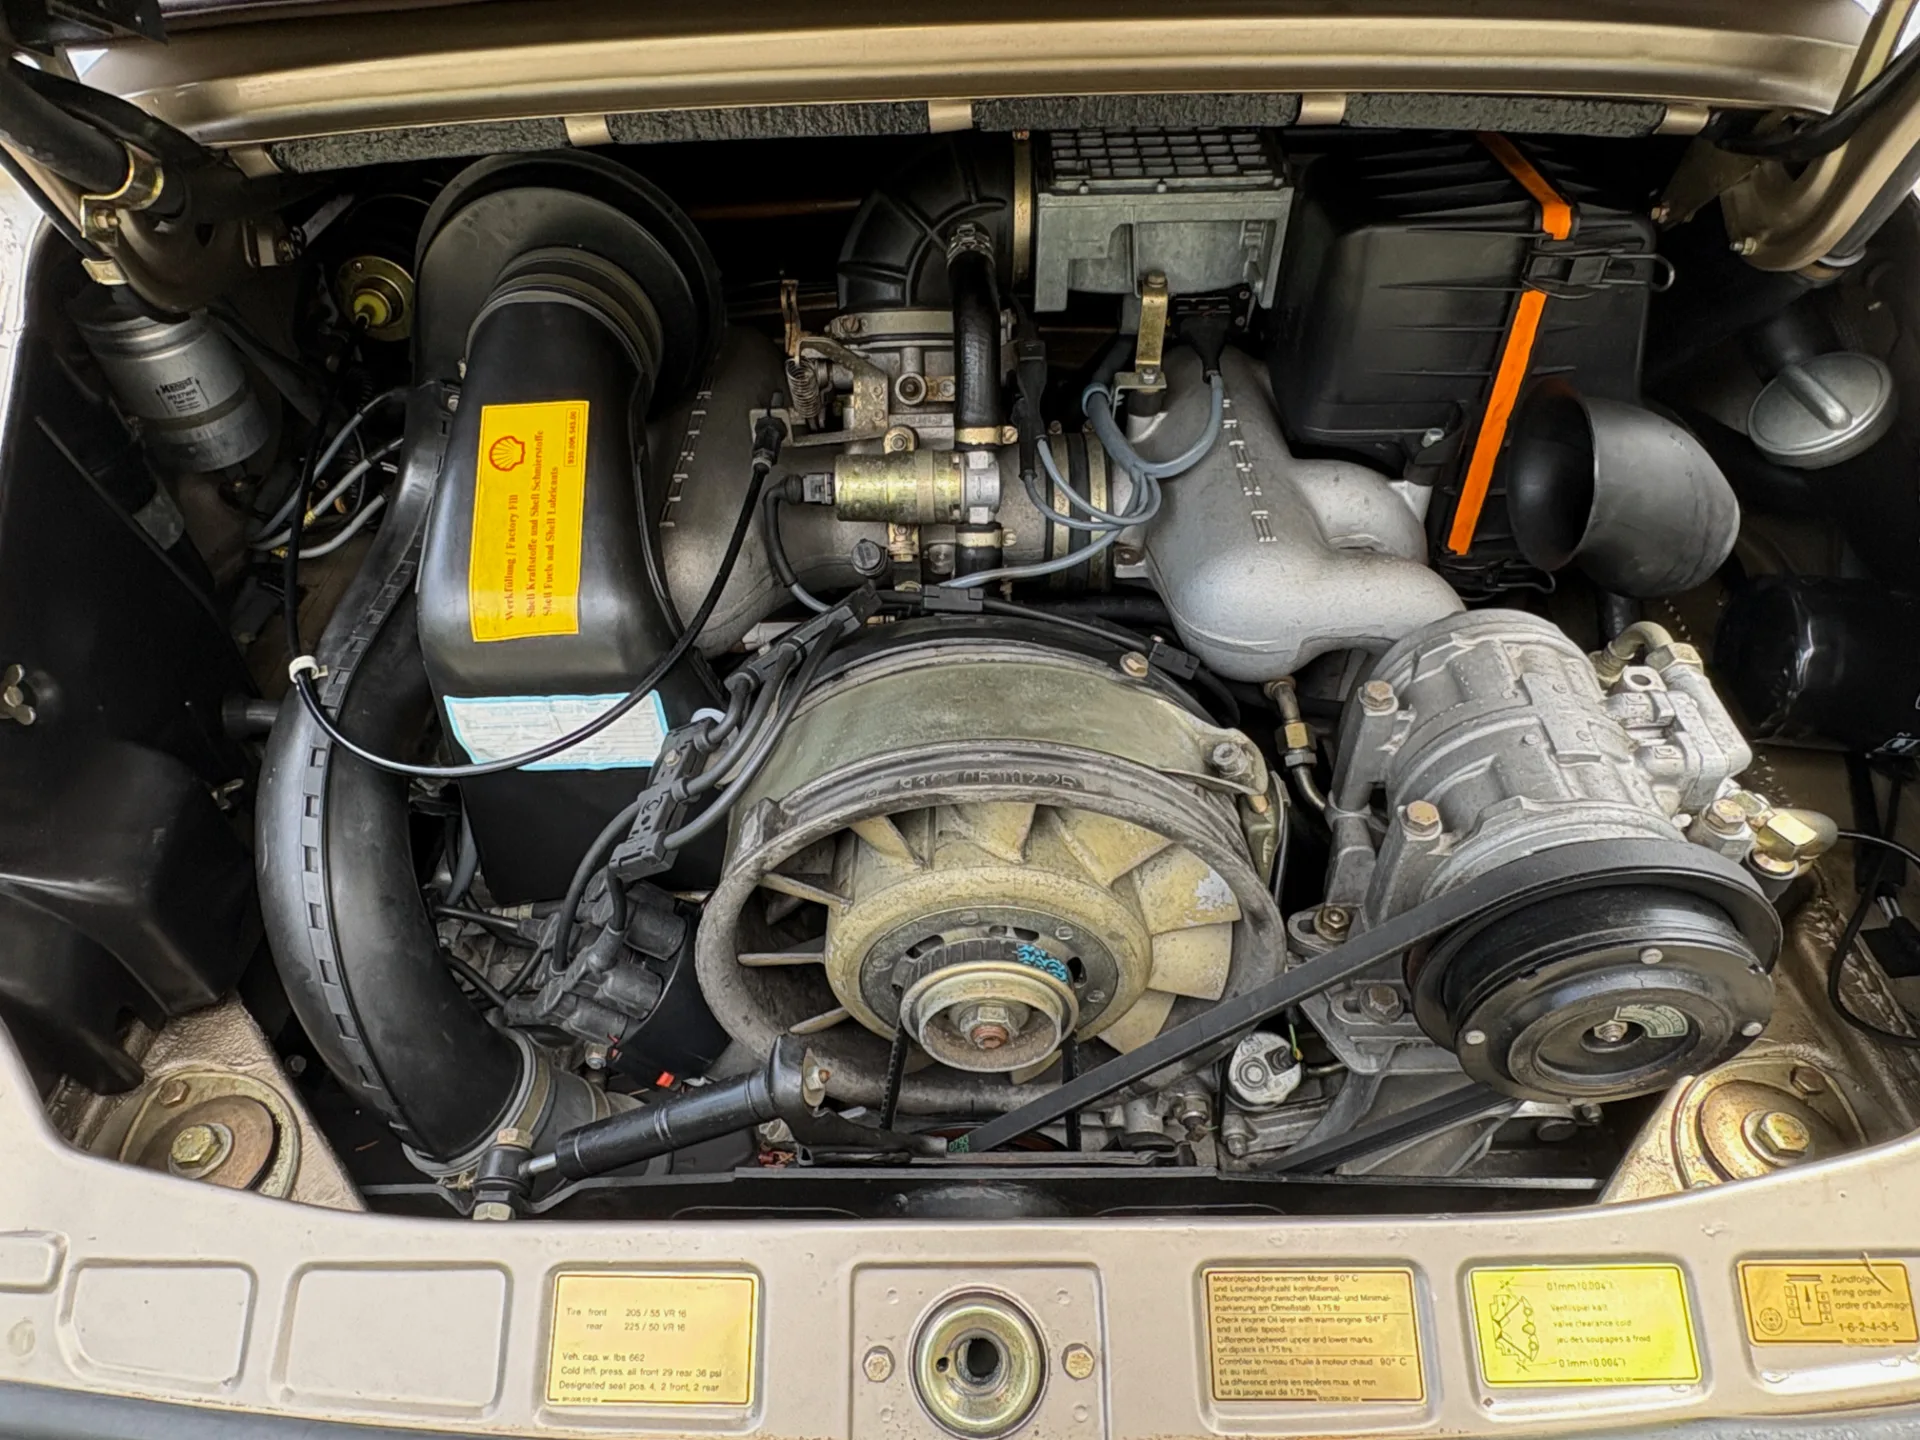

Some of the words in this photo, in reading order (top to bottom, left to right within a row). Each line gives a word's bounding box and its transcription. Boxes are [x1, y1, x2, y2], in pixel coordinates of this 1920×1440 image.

[532, 431, 543, 491] Schmierstoffe
[547, 467, 558, 514] Lubricants
[508, 495, 518, 510] Fill
[530, 494, 540, 516] Shell
[506, 514, 519, 548] Factory
[530, 520, 538, 536] und
[546, 518, 555, 541] Shell
[546, 545, 554, 560] and
[527, 539, 537, 590] Kraftstoffe
[544, 564, 553, 589] Fuels
[526, 594, 535, 617] Shell
[544, 592, 552, 616] Shell
[1832, 1289, 1854, 1298] firing
[1858, 1288, 1881, 1296] order
[567, 1308, 581, 1316] Tire
[588, 1308, 607, 1316] front
[625, 1309, 641, 1317] 205
[650, 1309, 660, 1317] 55
[678, 1310, 687, 1318] 16
[624, 1323, 640, 1331] 225
[649, 1323, 660, 1331] 50
[663, 1323, 674, 1331] VR
[1337, 1317, 1362, 1325] engine
[1839, 1322, 1899, 1332] 1-6-2-4-3-5
[1586, 1336, 1623, 1344] soupapes
[1229, 1346, 1256, 1354] dipstick
[629, 1354, 645, 1362] 662
[561, 1367, 580, 1375] Cold
[640, 1368, 658, 1376] front
[663, 1368, 673, 1376] 29
[696, 1369, 706, 1377] 36
[710, 1370, 722, 1378] psi
[559, 1381, 605, 1390] Designated
[694, 1383, 699, 1391] 2
[702, 1384, 719, 1392] rear
